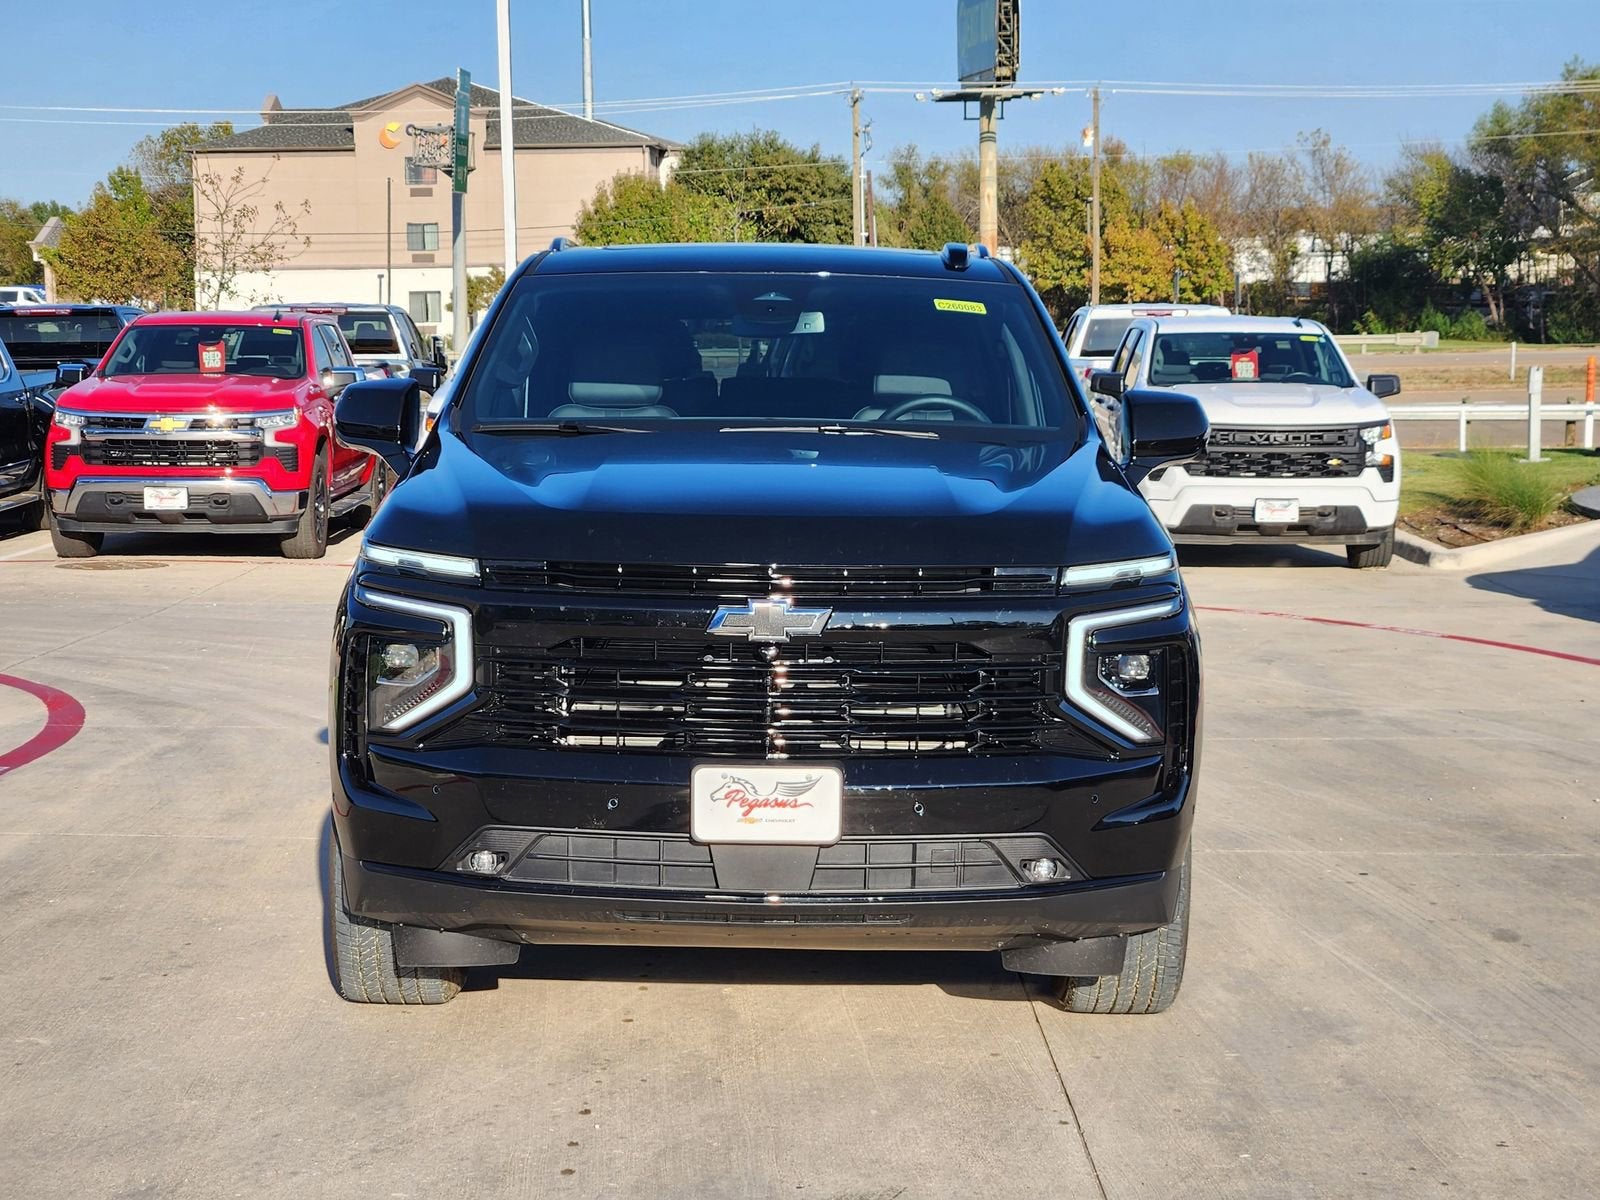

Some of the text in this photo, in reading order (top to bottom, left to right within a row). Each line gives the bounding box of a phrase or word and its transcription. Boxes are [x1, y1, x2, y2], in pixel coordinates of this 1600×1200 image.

[202, 351, 221, 360] RED
[204, 359, 221, 368] TAG
[1211, 430, 1356, 447] HEVROLET
[724, 789, 814, 817] Pegasus
